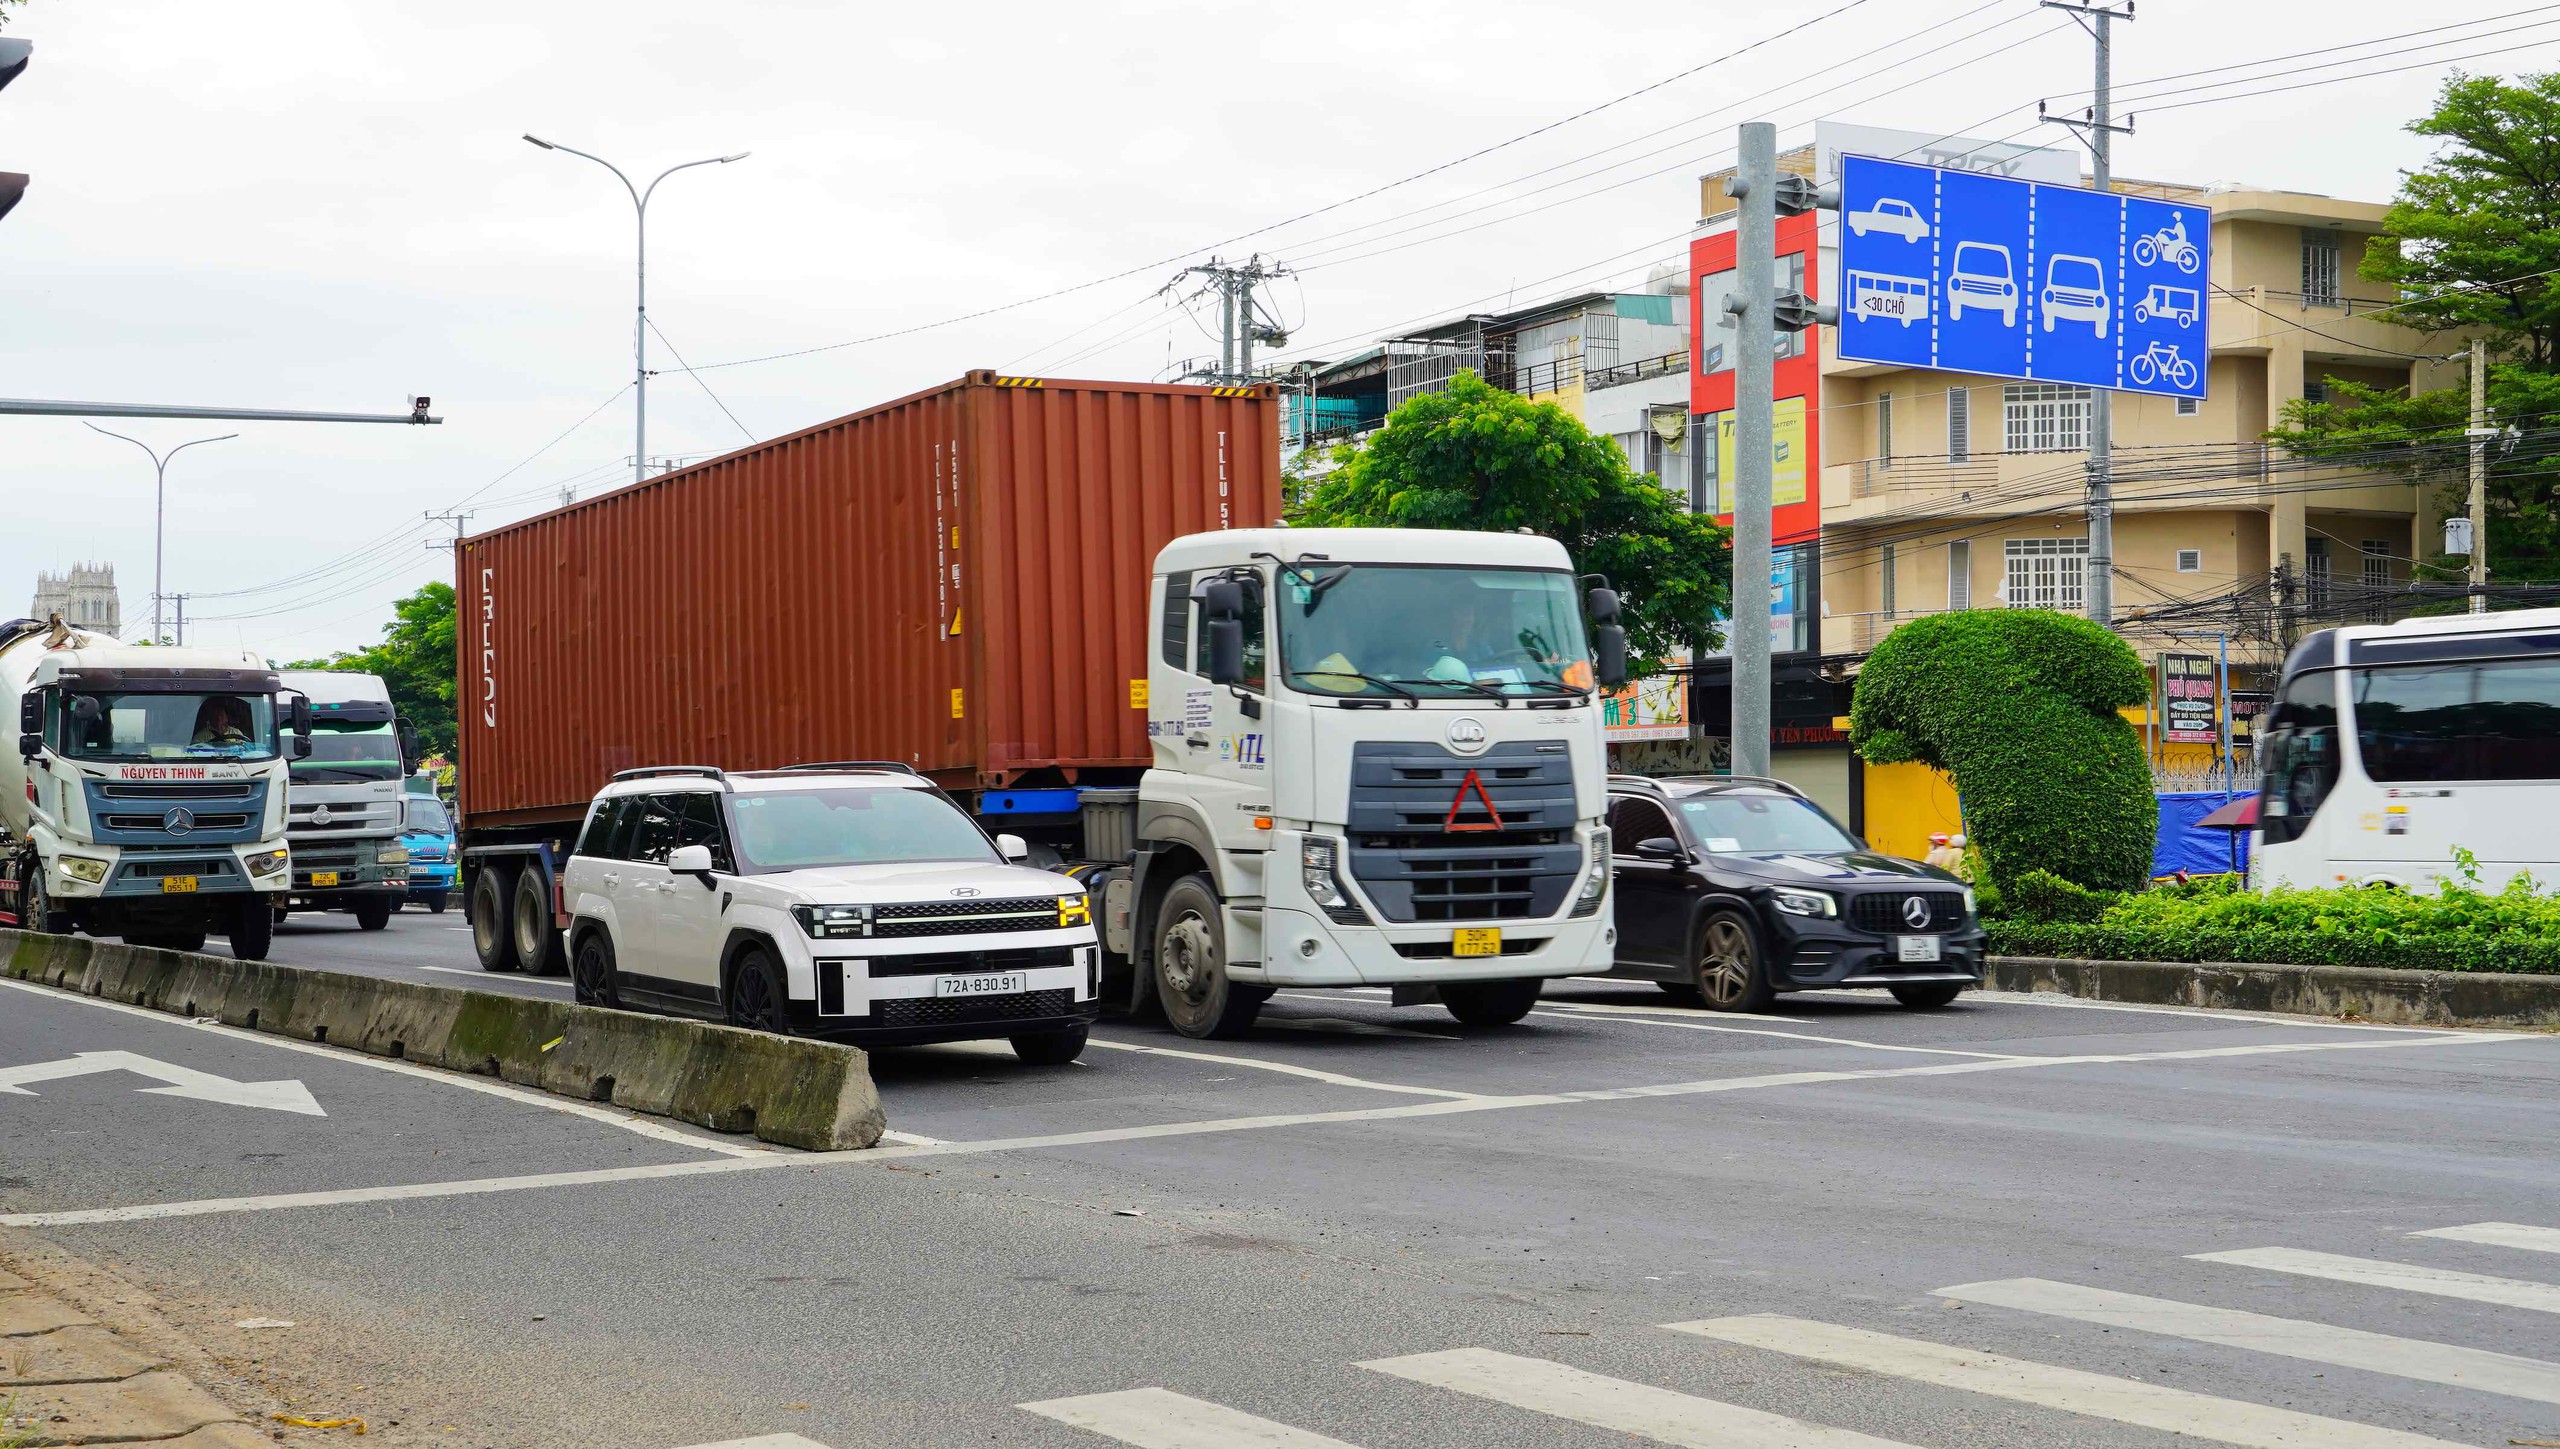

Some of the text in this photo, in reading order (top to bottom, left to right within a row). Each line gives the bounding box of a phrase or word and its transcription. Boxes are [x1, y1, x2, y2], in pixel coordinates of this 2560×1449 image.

[1864, 296, 1905, 315] <30 CHỖ
[1217, 431, 1228, 497] TLLU
[2167, 656, 2212, 675] NHÀ NGHỈ
[2185, 680, 2213, 700] QUANG
[1627, 698, 1637, 726] 3
[121, 767, 206, 779] NGUYEN THINH
[167, 884, 193, 892] 055.11
[173, 877, 187, 885] 51E
[945, 977, 1017, 993] 72A-830.91
